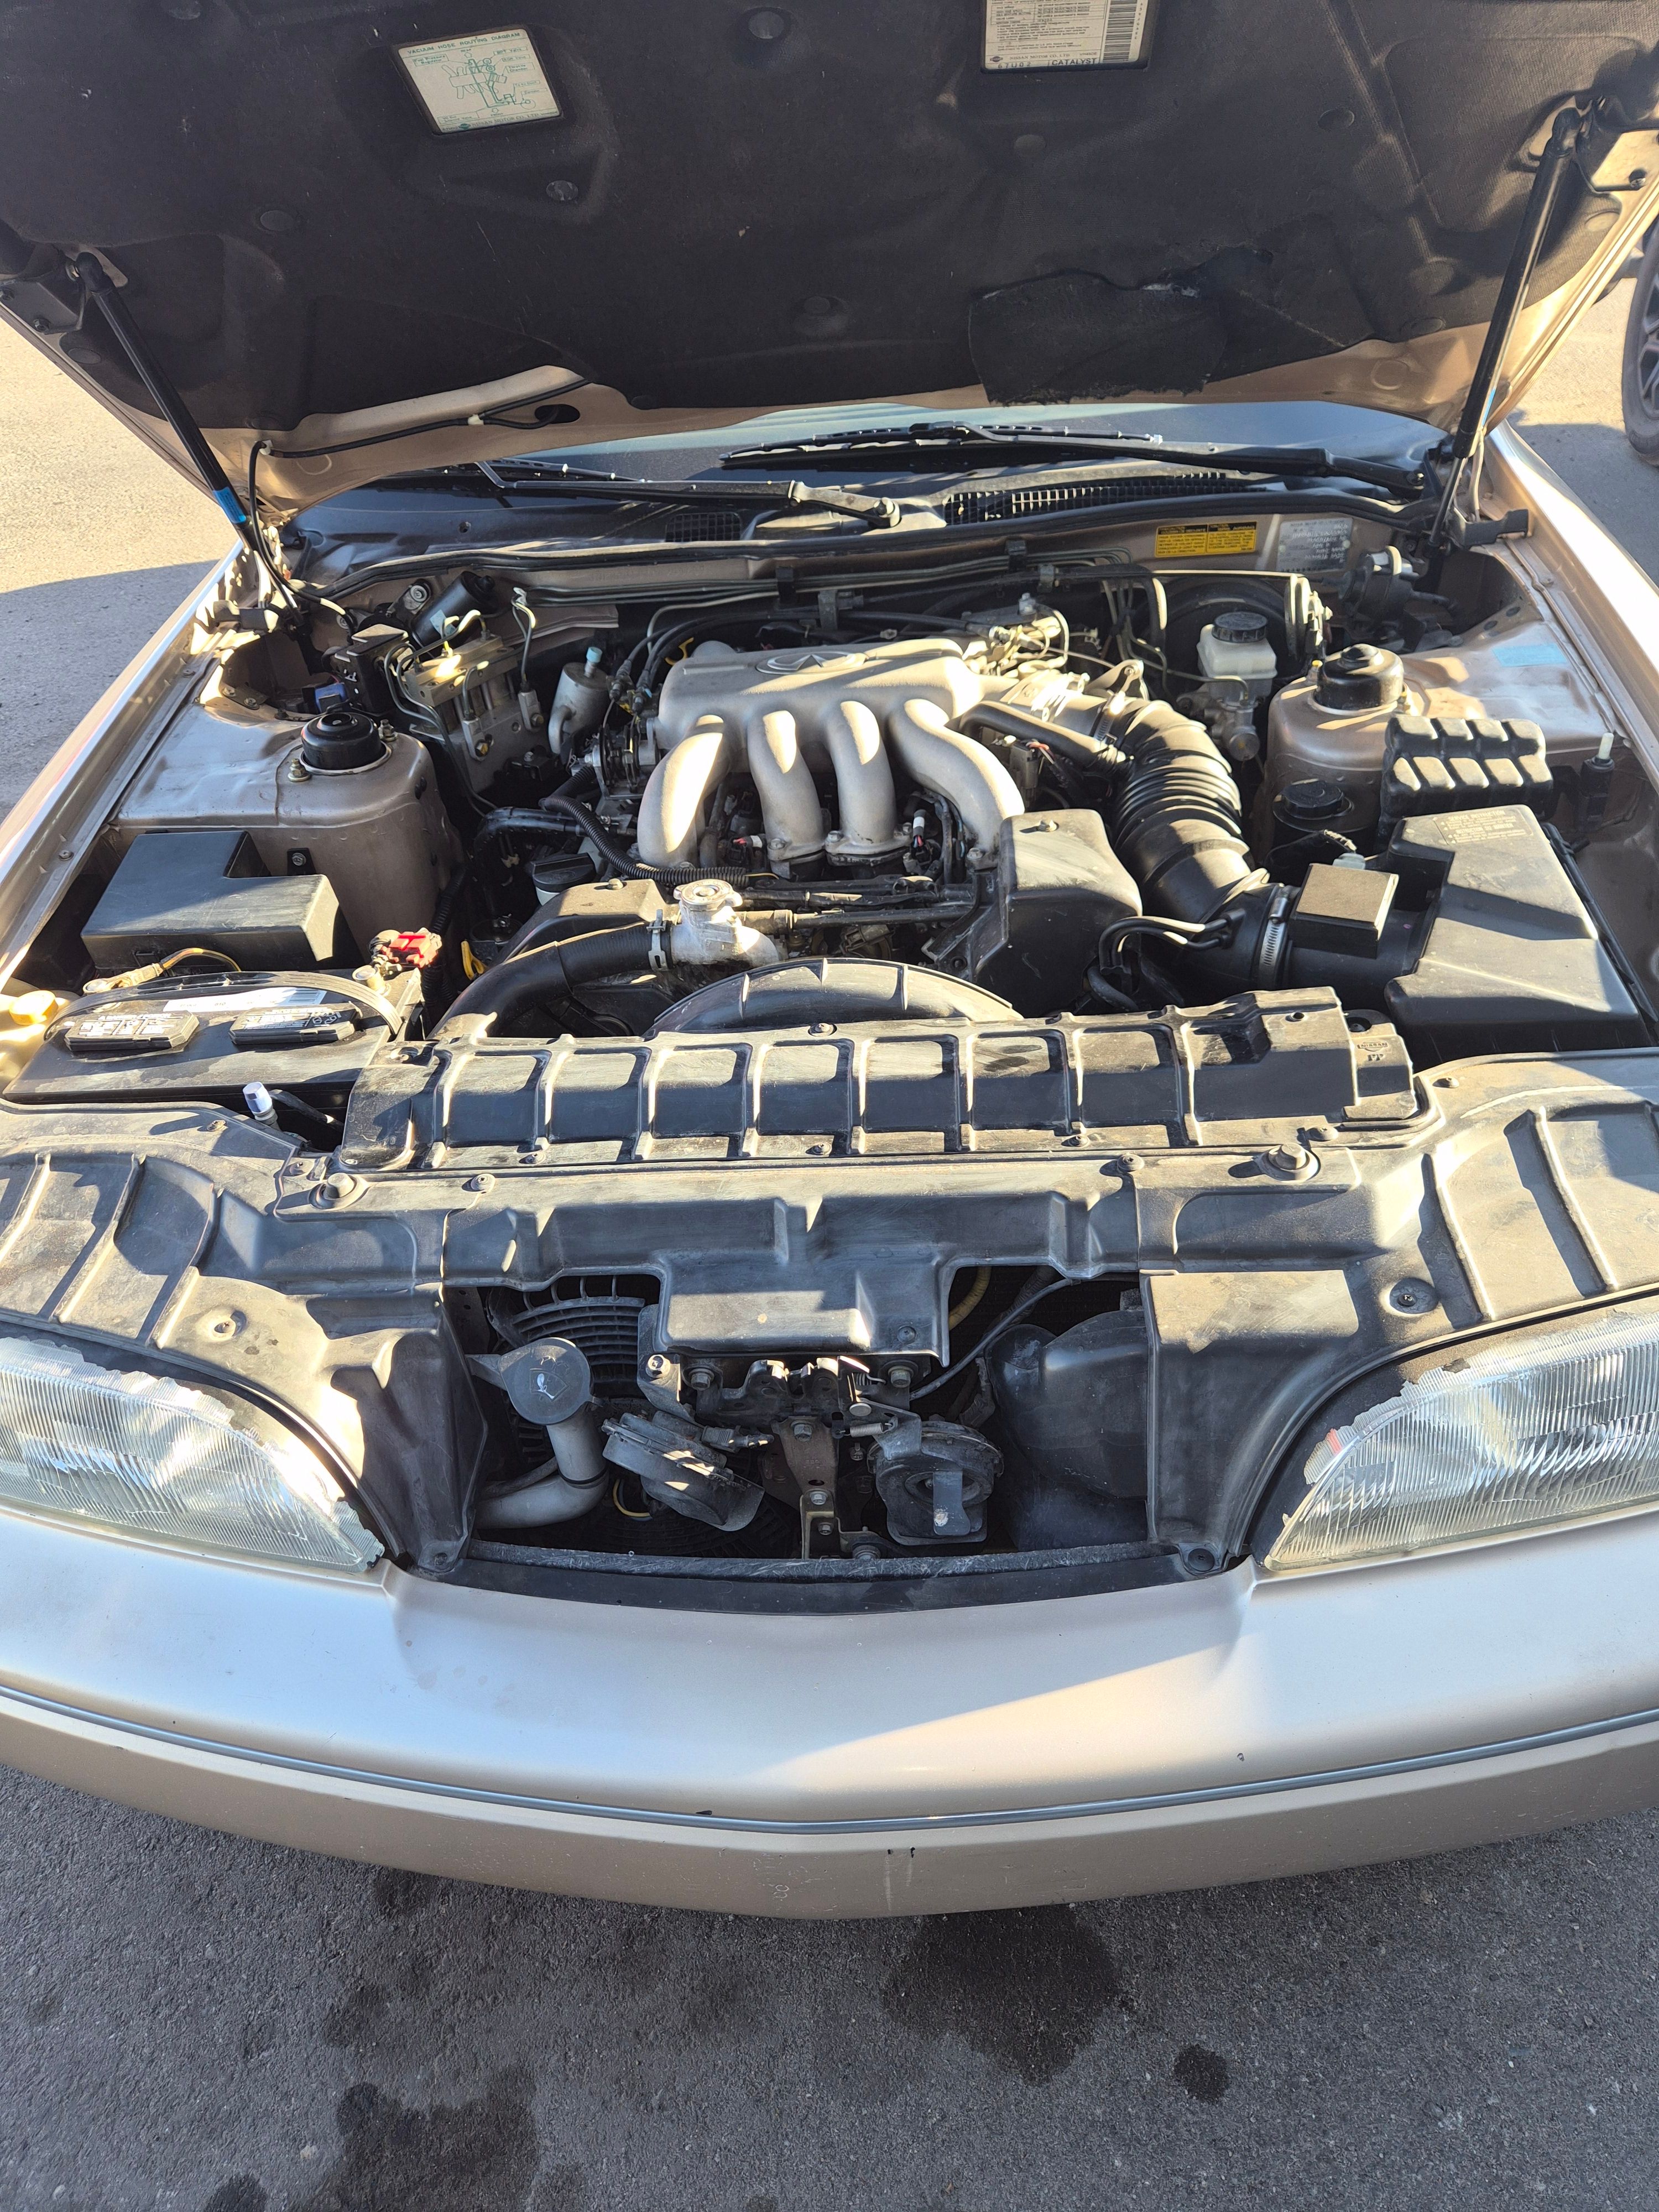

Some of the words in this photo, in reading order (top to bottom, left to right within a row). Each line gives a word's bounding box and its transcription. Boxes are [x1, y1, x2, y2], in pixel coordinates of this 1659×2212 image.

[408, 46, 435, 55] VACUUM
[460, 38, 488, 46] ROUTING
[491, 33, 521, 41] DIAGRAM
[1052, 58, 1097, 66] CATALYST
